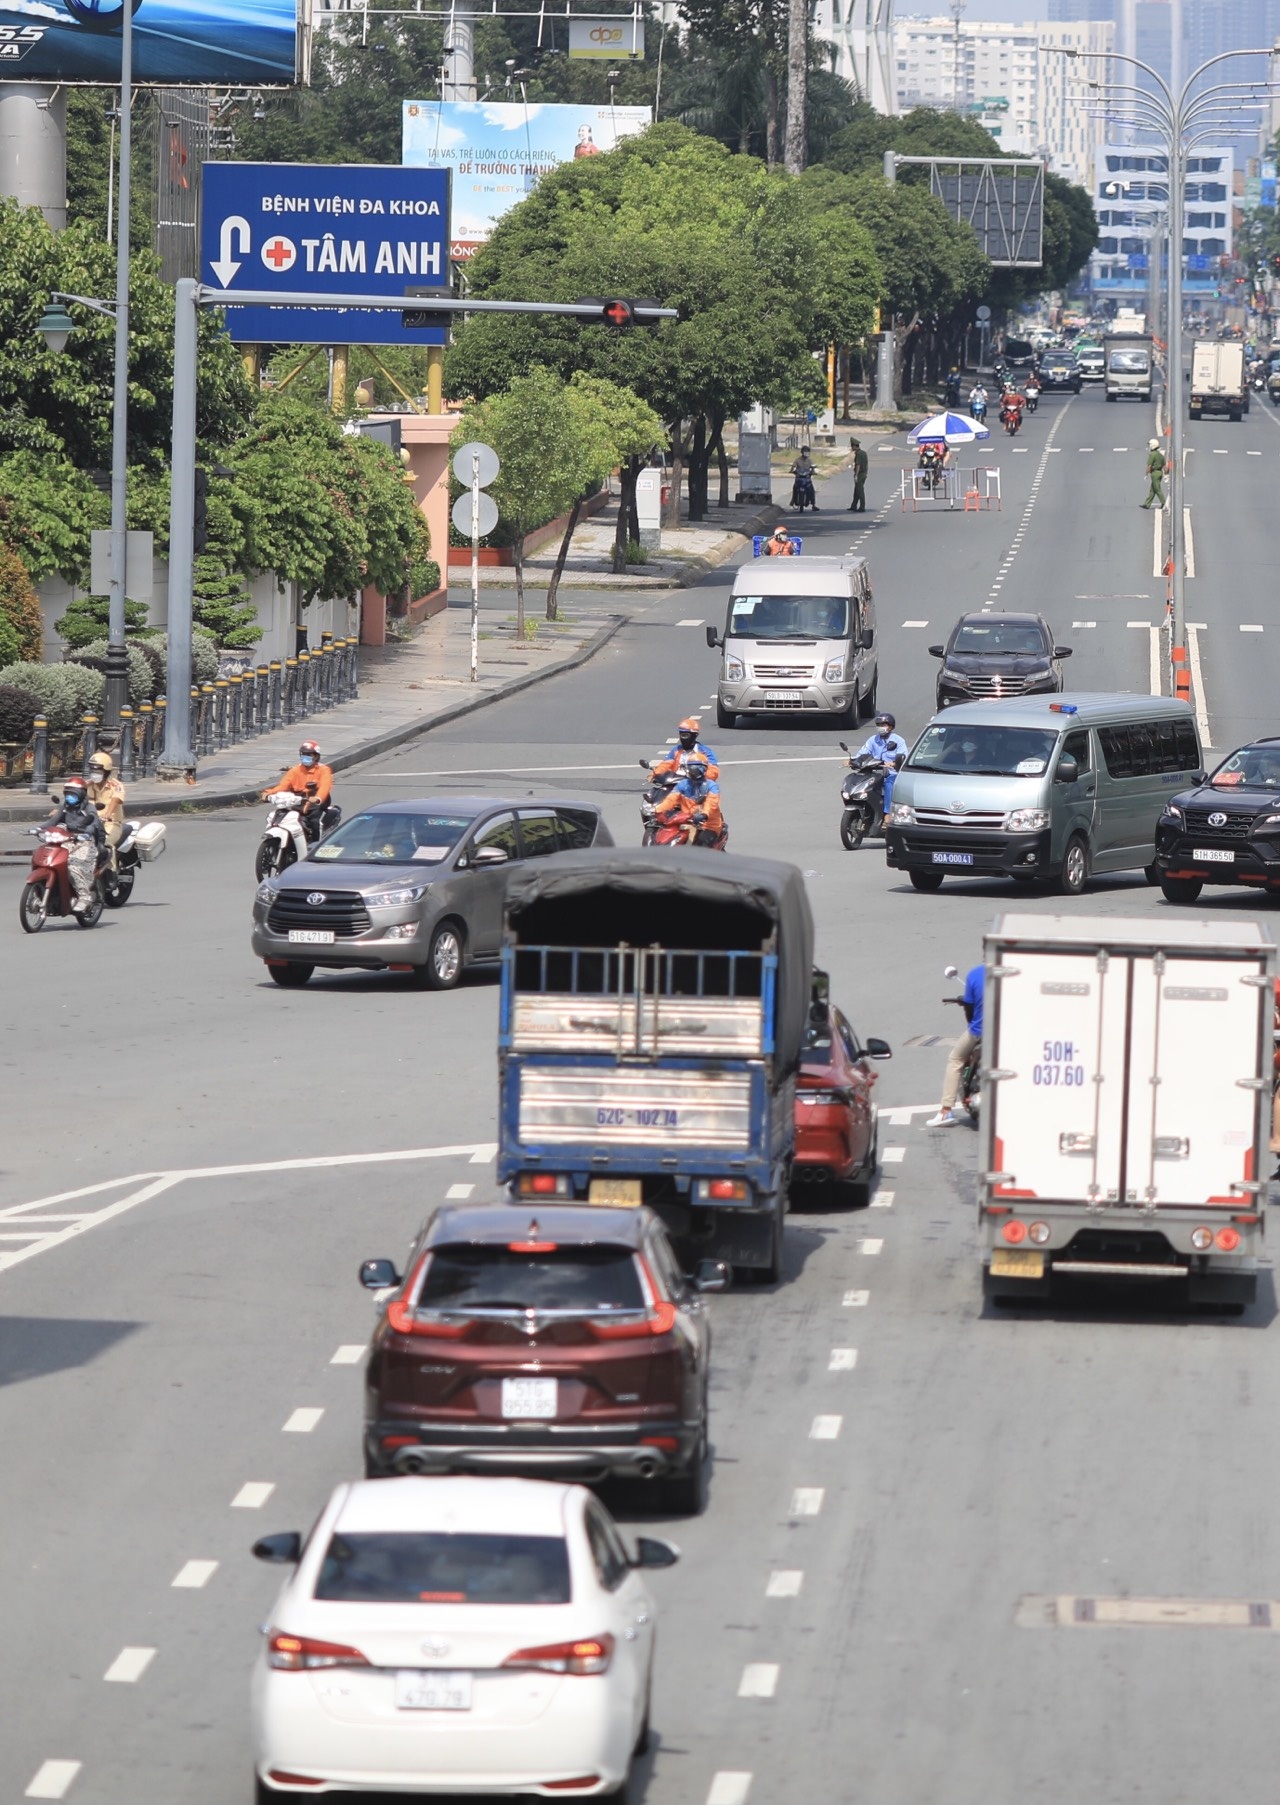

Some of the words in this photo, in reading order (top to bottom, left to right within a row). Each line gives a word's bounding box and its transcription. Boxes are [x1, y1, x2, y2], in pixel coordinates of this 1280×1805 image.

[475, 148, 496, 160] LUÔN
[498, 148, 509, 160] CÓ
[510, 149, 531, 160] CÁCH
[475, 160, 517, 175] TRƯỞNG
[484, 185, 496, 193] the
[261, 194, 310, 215] BỆNH
[313, 195, 355, 216] VIỆN
[359, 199, 385, 214] ĐA
[389, 199, 440, 216] KHOA
[301, 232, 367, 273] TÂM
[374, 240, 440, 275] ANH
[1032, 1064, 1085, 1087] 037.60
[636, 1109, 678, 1127] 102.74
